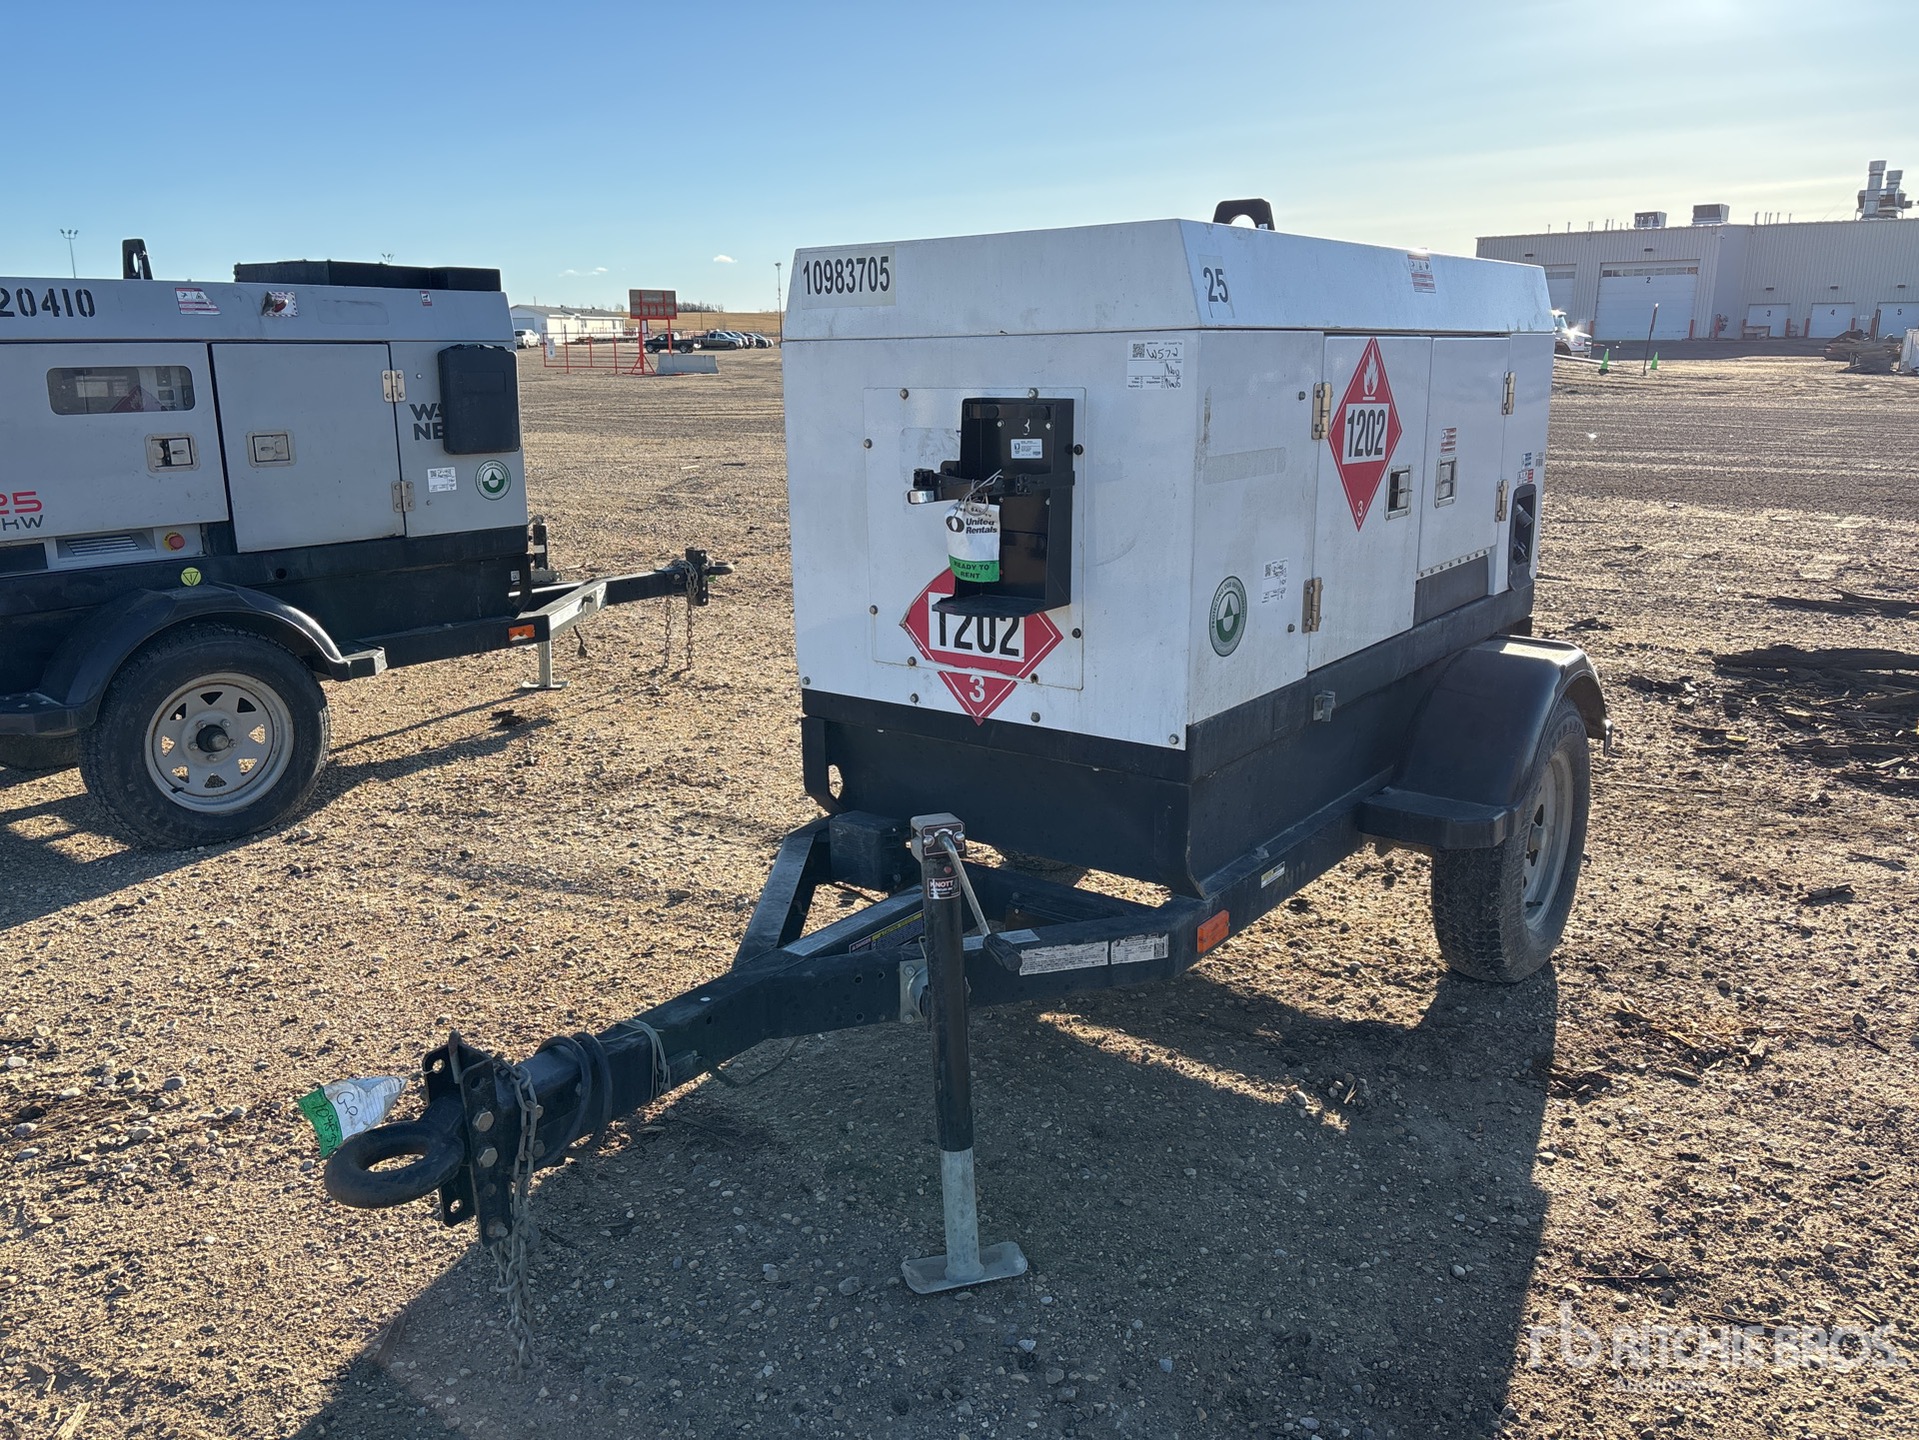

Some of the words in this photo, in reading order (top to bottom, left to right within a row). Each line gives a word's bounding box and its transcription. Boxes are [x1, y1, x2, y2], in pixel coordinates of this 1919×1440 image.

[803, 256, 890, 295] 10983705
[1645, 276, 1651, 284] 2
[1203, 267, 1229, 303] 25
[0, 287, 96, 318] 20410
[1766, 309, 1772, 317] 3
[1830, 308, 1836, 316] 4
[1897, 308, 1902, 316] 5
[1347, 409, 1386, 458] 1202
[1357, 499, 1364, 517] 3
[966, 517, 995, 527] United
[966, 526, 998, 535] Rentals
[953, 560, 977, 570] READY
[960, 571, 981, 579] RENT
[938, 610, 1020, 657] 1202
[969, 675, 986, 703] 3
